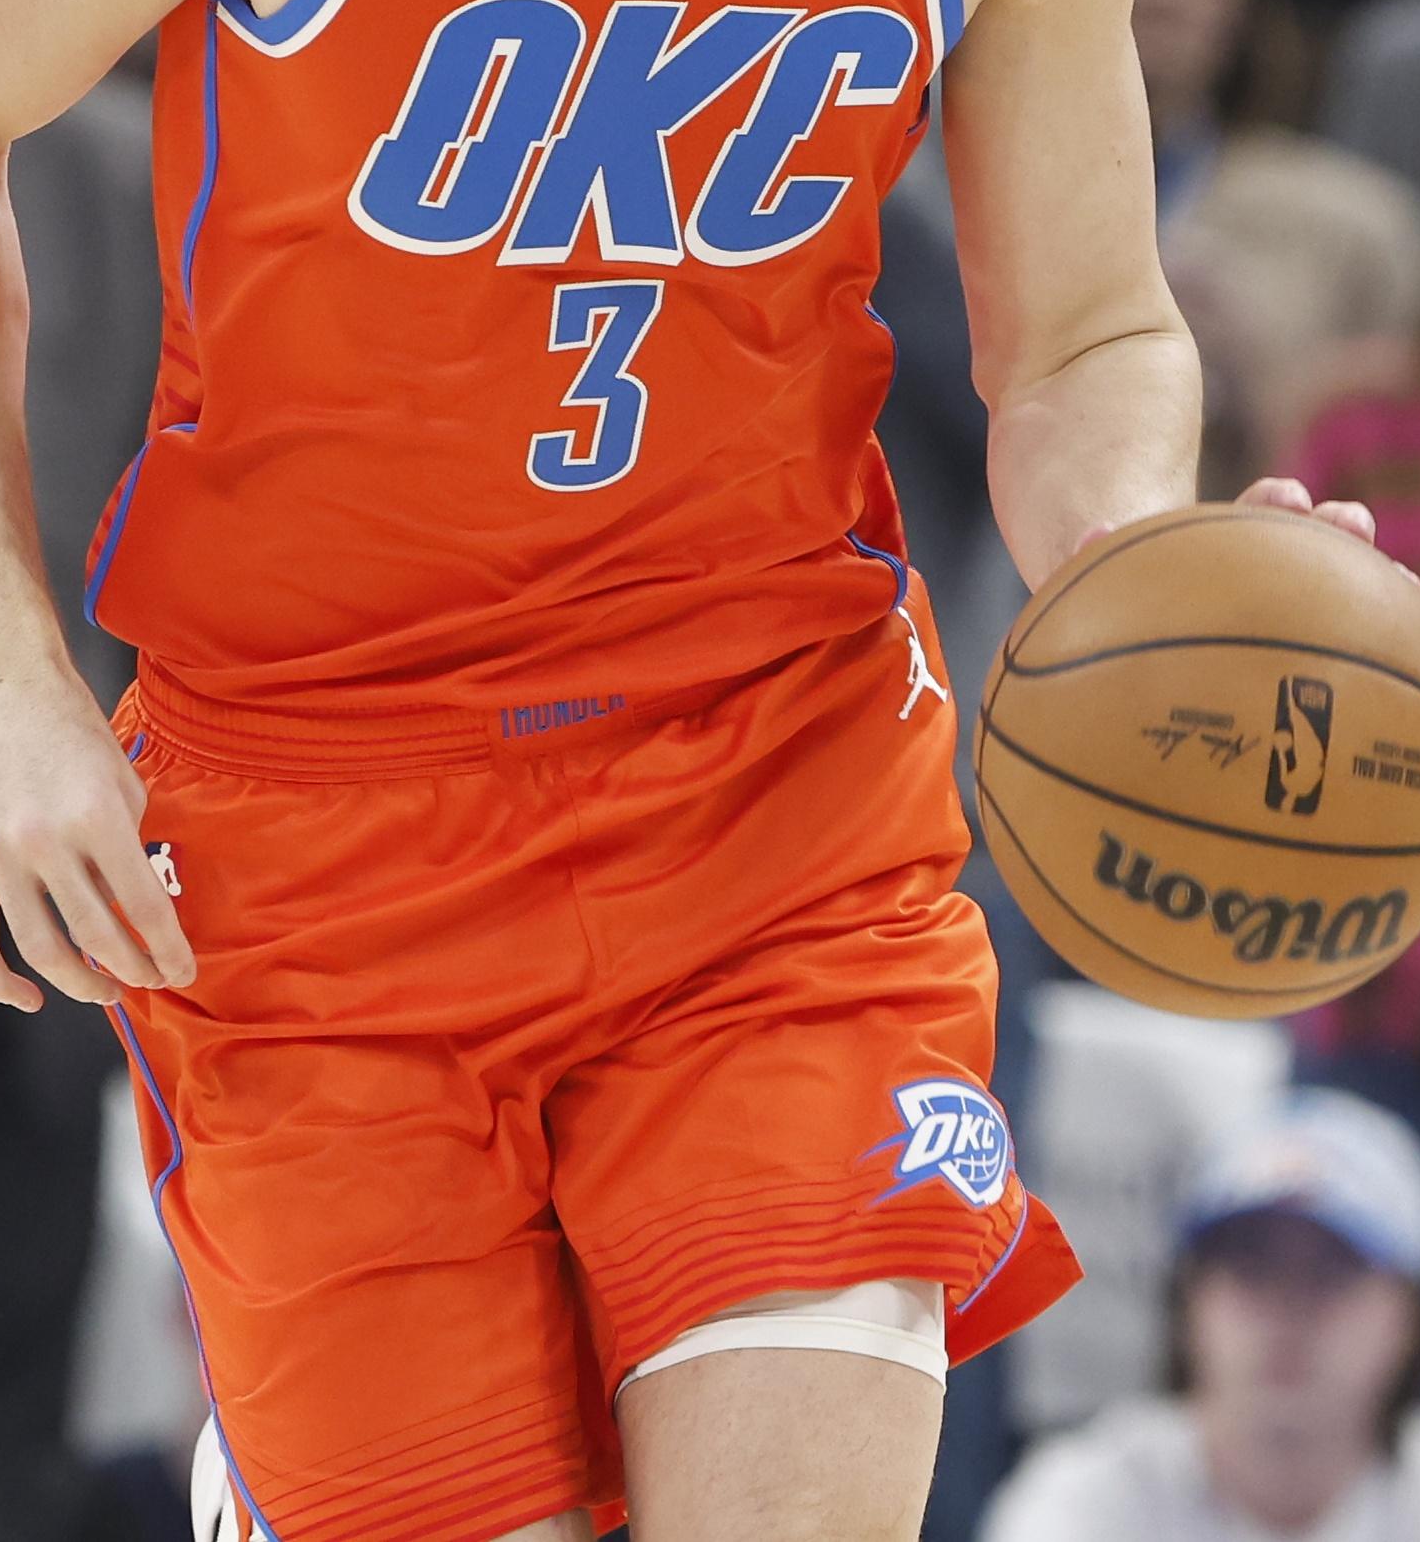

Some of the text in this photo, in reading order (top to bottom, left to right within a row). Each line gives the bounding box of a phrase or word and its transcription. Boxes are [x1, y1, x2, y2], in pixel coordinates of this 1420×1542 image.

[526, 279, 665, 492] 3
[1093, 829, 1409, 964] Wilson
[900, 1112, 996, 1174] OKC
